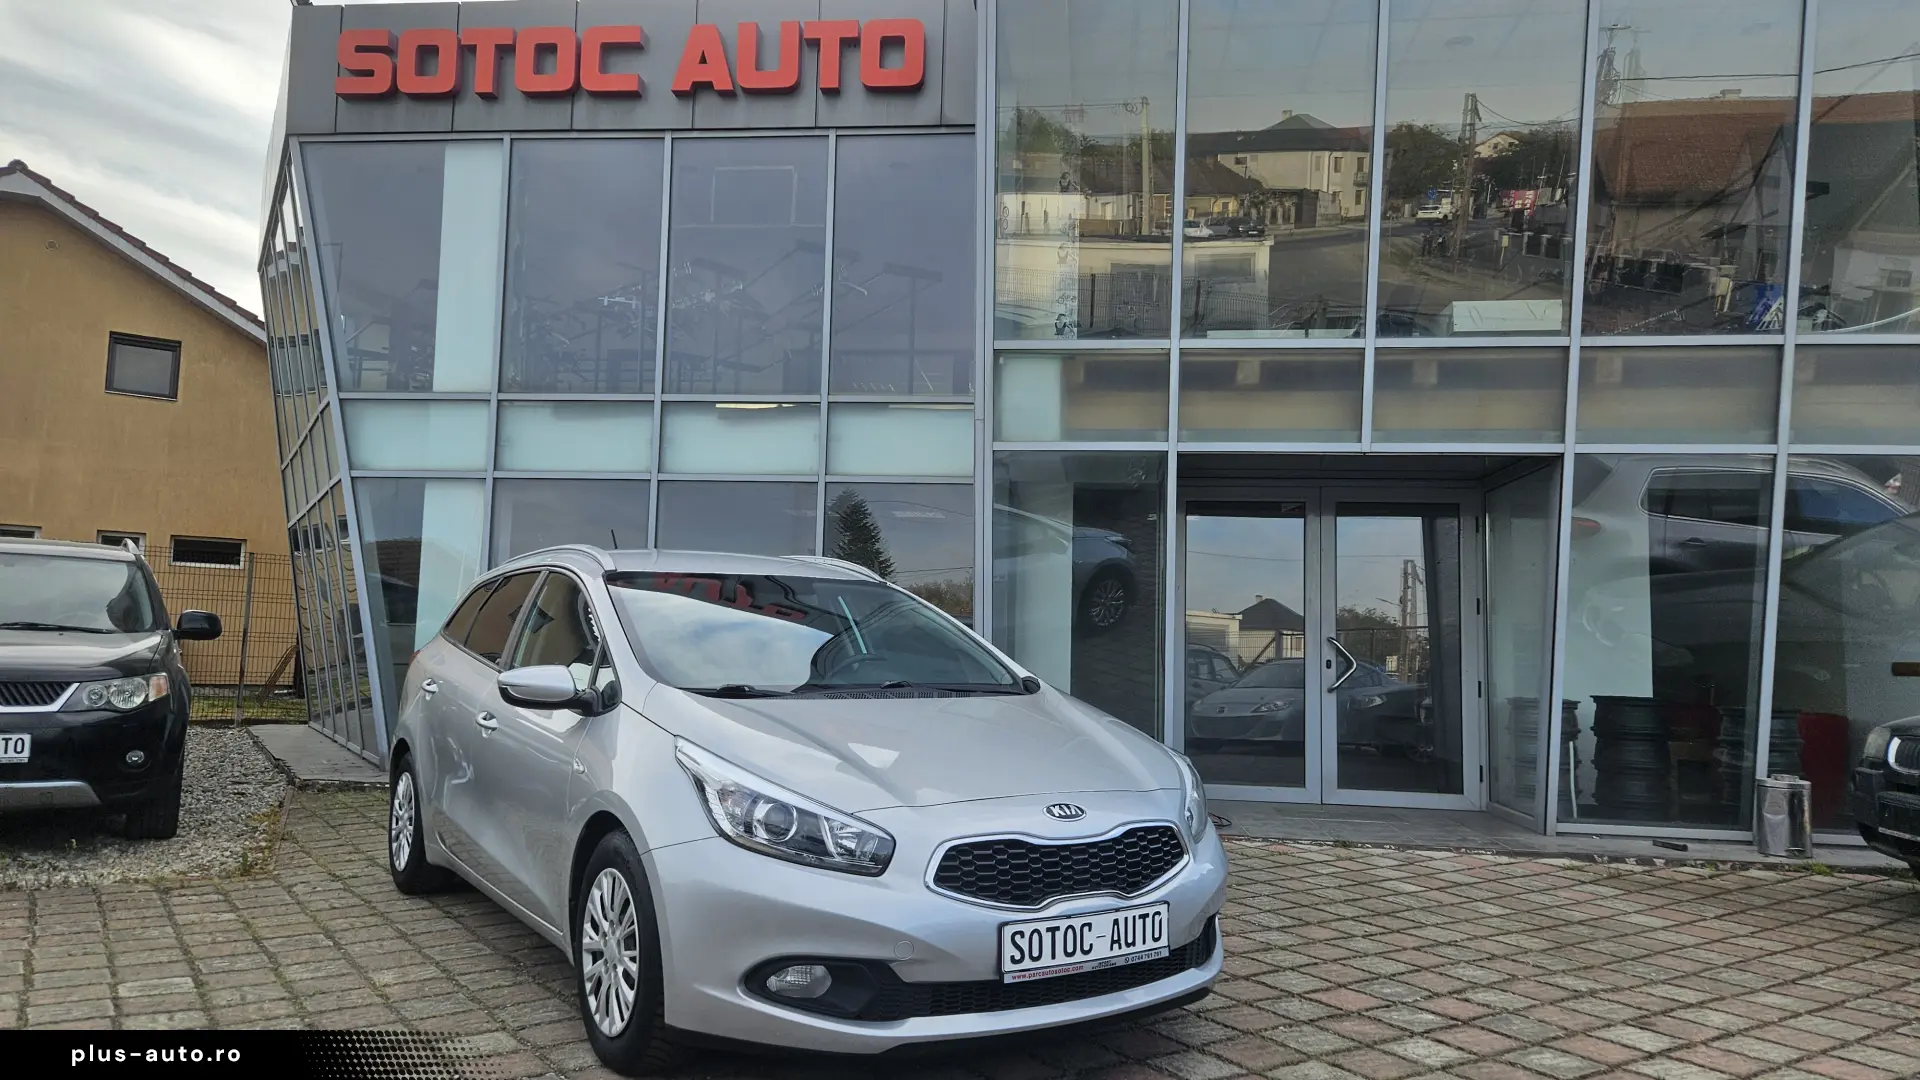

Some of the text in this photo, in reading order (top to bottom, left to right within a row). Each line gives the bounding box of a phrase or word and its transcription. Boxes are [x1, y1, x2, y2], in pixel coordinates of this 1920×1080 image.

[336, 18, 925, 100] SOTOC AUTO
[1049, 804, 1083, 817] KIA
[1011, 965, 1084, 980] www.parcautosotoc.com
